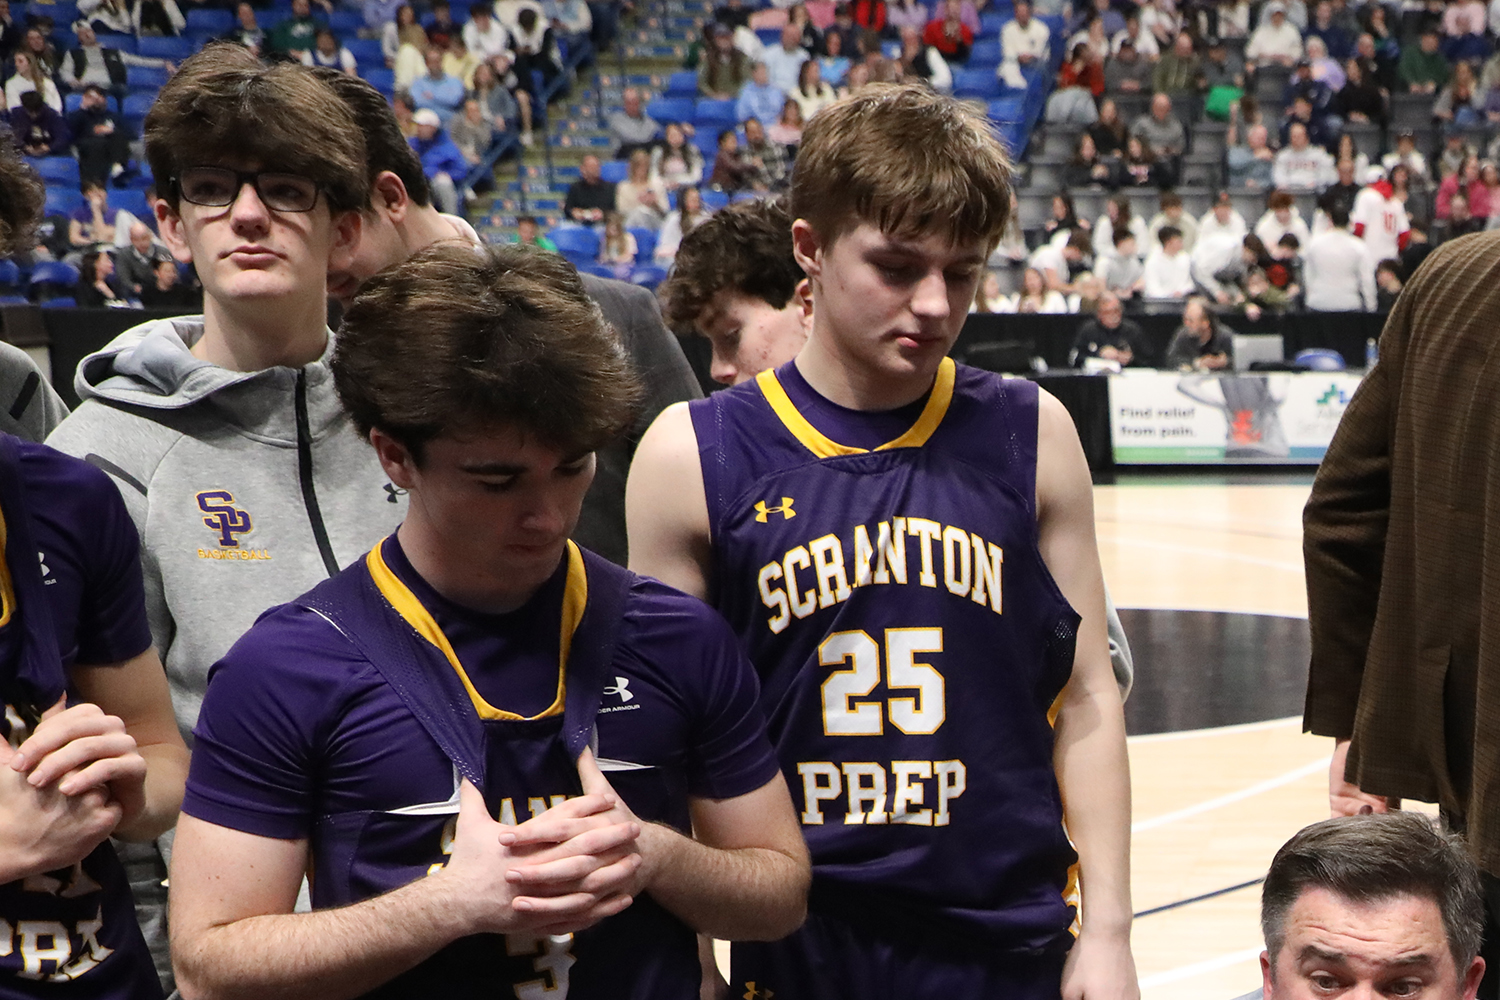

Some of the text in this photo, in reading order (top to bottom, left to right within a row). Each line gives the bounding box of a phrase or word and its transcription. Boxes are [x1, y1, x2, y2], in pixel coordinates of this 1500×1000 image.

[1120, 407, 1195, 418] Find relief
[1121, 426, 1156, 437] from
[197, 548, 272, 560] BASKETBALL
[758, 516, 1004, 635] SCRANTON
[818, 627, 946, 736] 25
[797, 759, 967, 826] PREP
